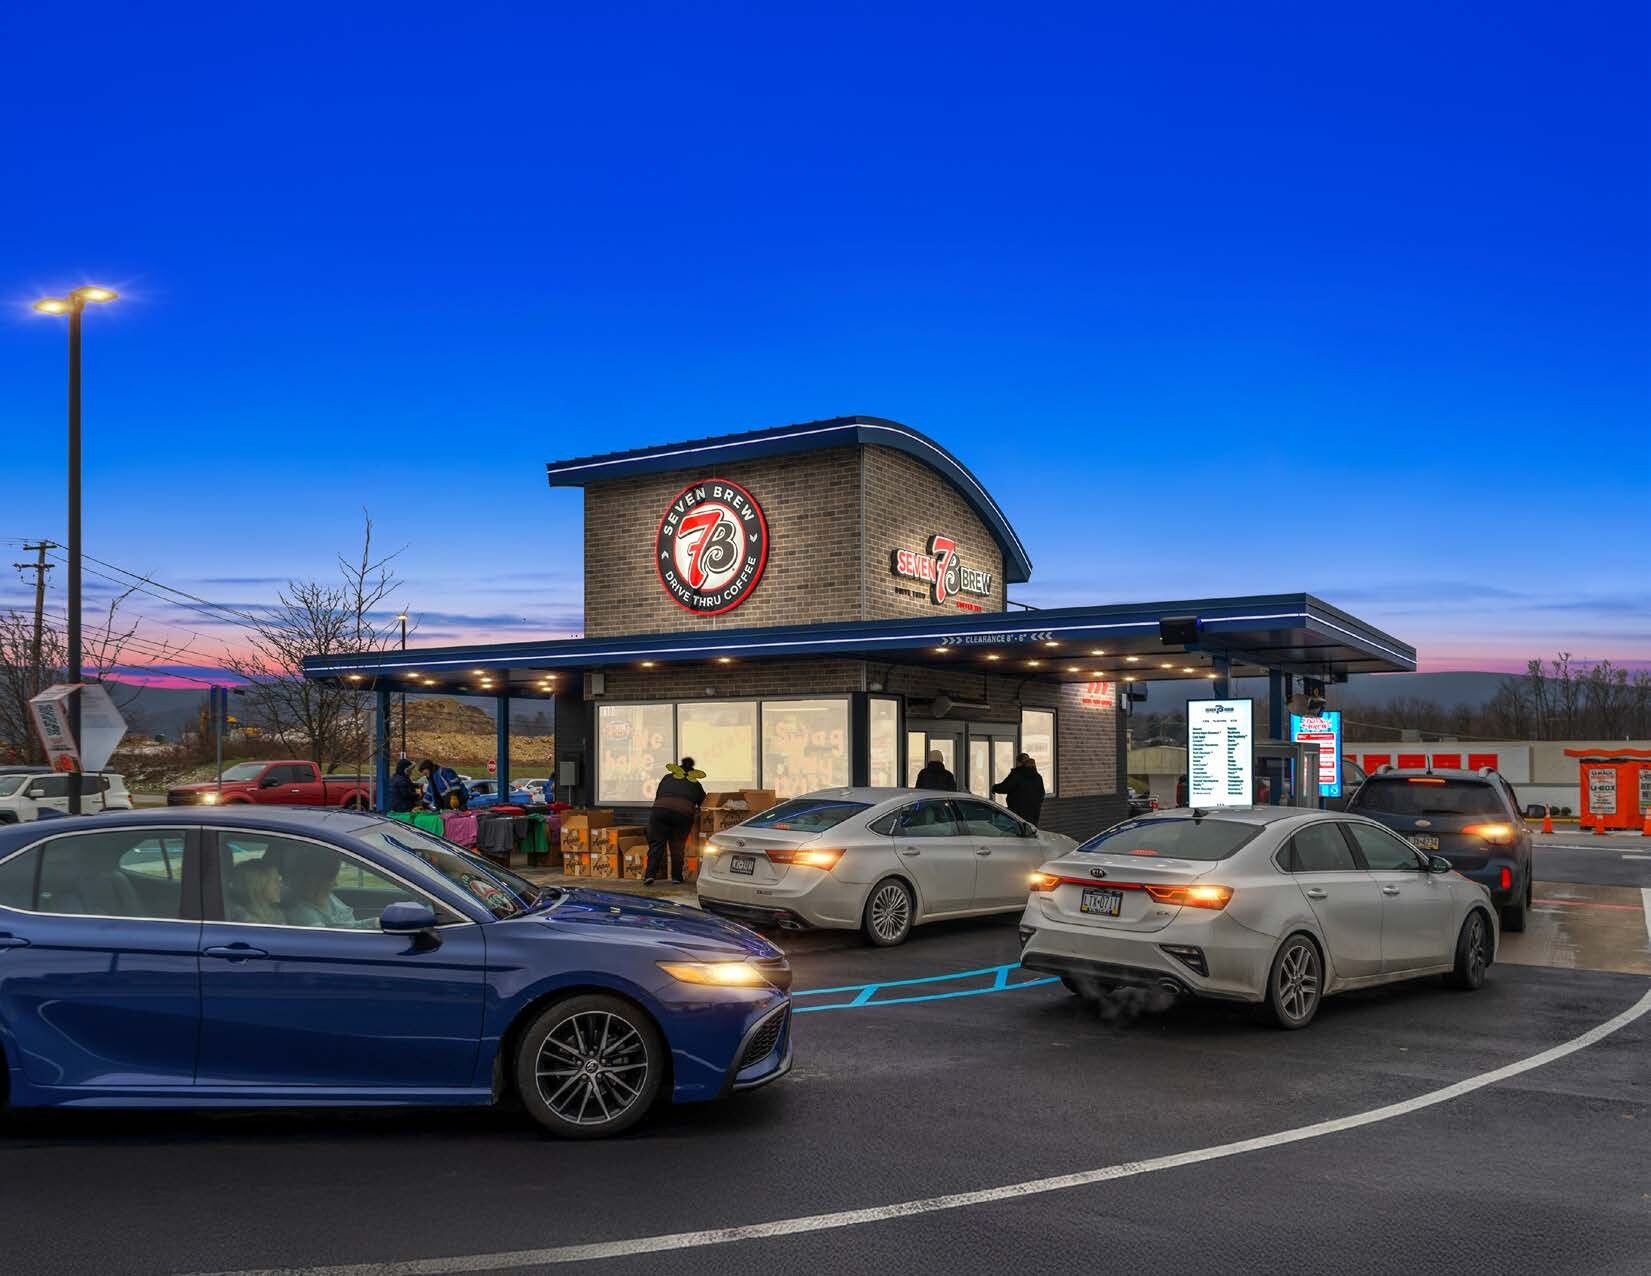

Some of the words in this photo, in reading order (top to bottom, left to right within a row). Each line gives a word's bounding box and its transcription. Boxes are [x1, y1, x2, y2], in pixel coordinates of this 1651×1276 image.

[663, 487, 706, 536] SEVEN
[713, 486, 755, 521] BREW
[665, 571, 691, 602] DRIVE
[693, 595, 721, 607] THRU
[724, 556, 756, 600] COFFEE
[897, 550, 936, 581] SEVEN
[960, 566, 992, 595] BREW
[965, 634, 1006, 644] CLEARANCE
[1092, 869, 1104, 877] KIA
